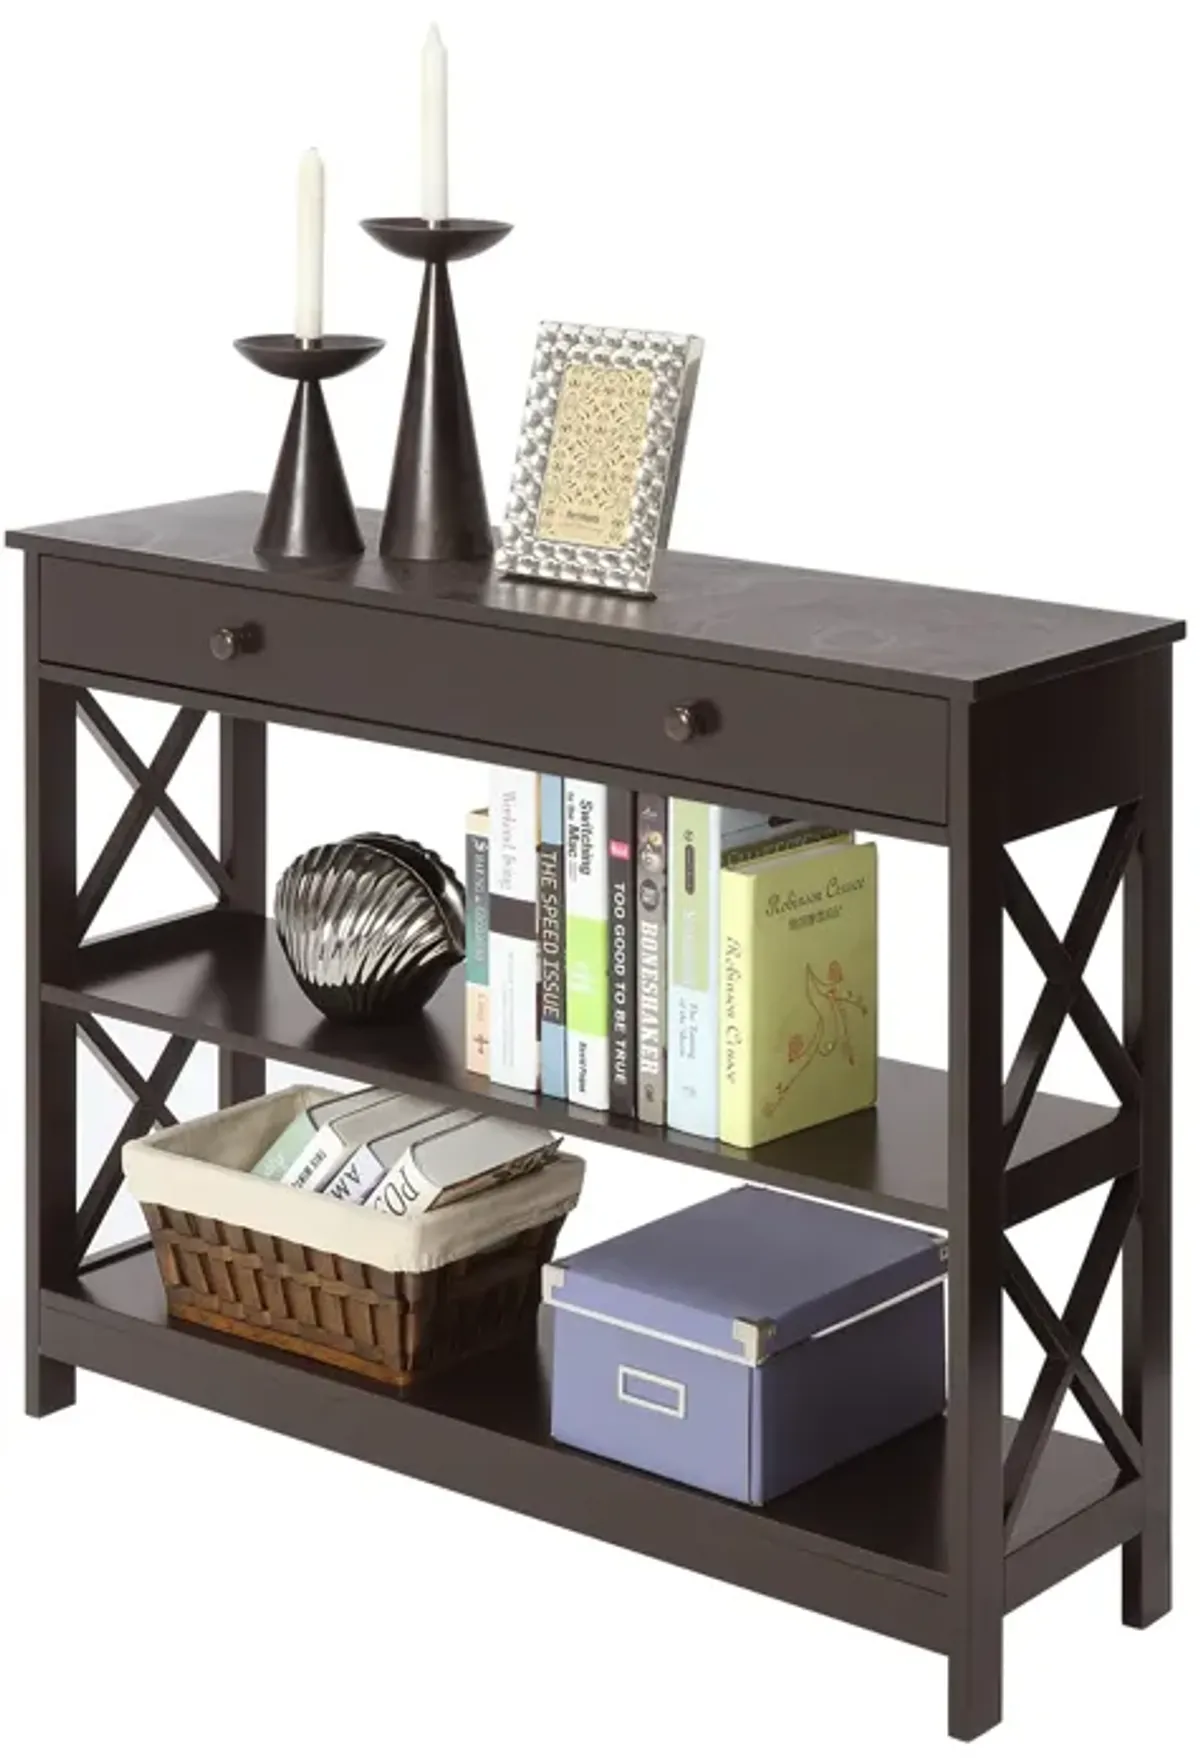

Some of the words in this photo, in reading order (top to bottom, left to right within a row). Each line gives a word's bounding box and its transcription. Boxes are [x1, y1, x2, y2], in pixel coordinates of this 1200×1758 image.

[568, 824, 580, 858] Mac
[580, 798, 593, 876] Switching
[541, 852, 558, 890] THE
[541, 893, 559, 954] SPEED
[614, 883, 625, 919] TOO
[614, 924, 625, 976] GOOD
[542, 958, 560, 1018] ISSUE
[614, 982, 626, 1005] TO
[641, 920, 659, 1075] BONESHAKER
[725, 936, 742, 1019] Robinson
[614, 1010, 626, 1033] BE
[614, 1039, 627, 1085] TRUE
